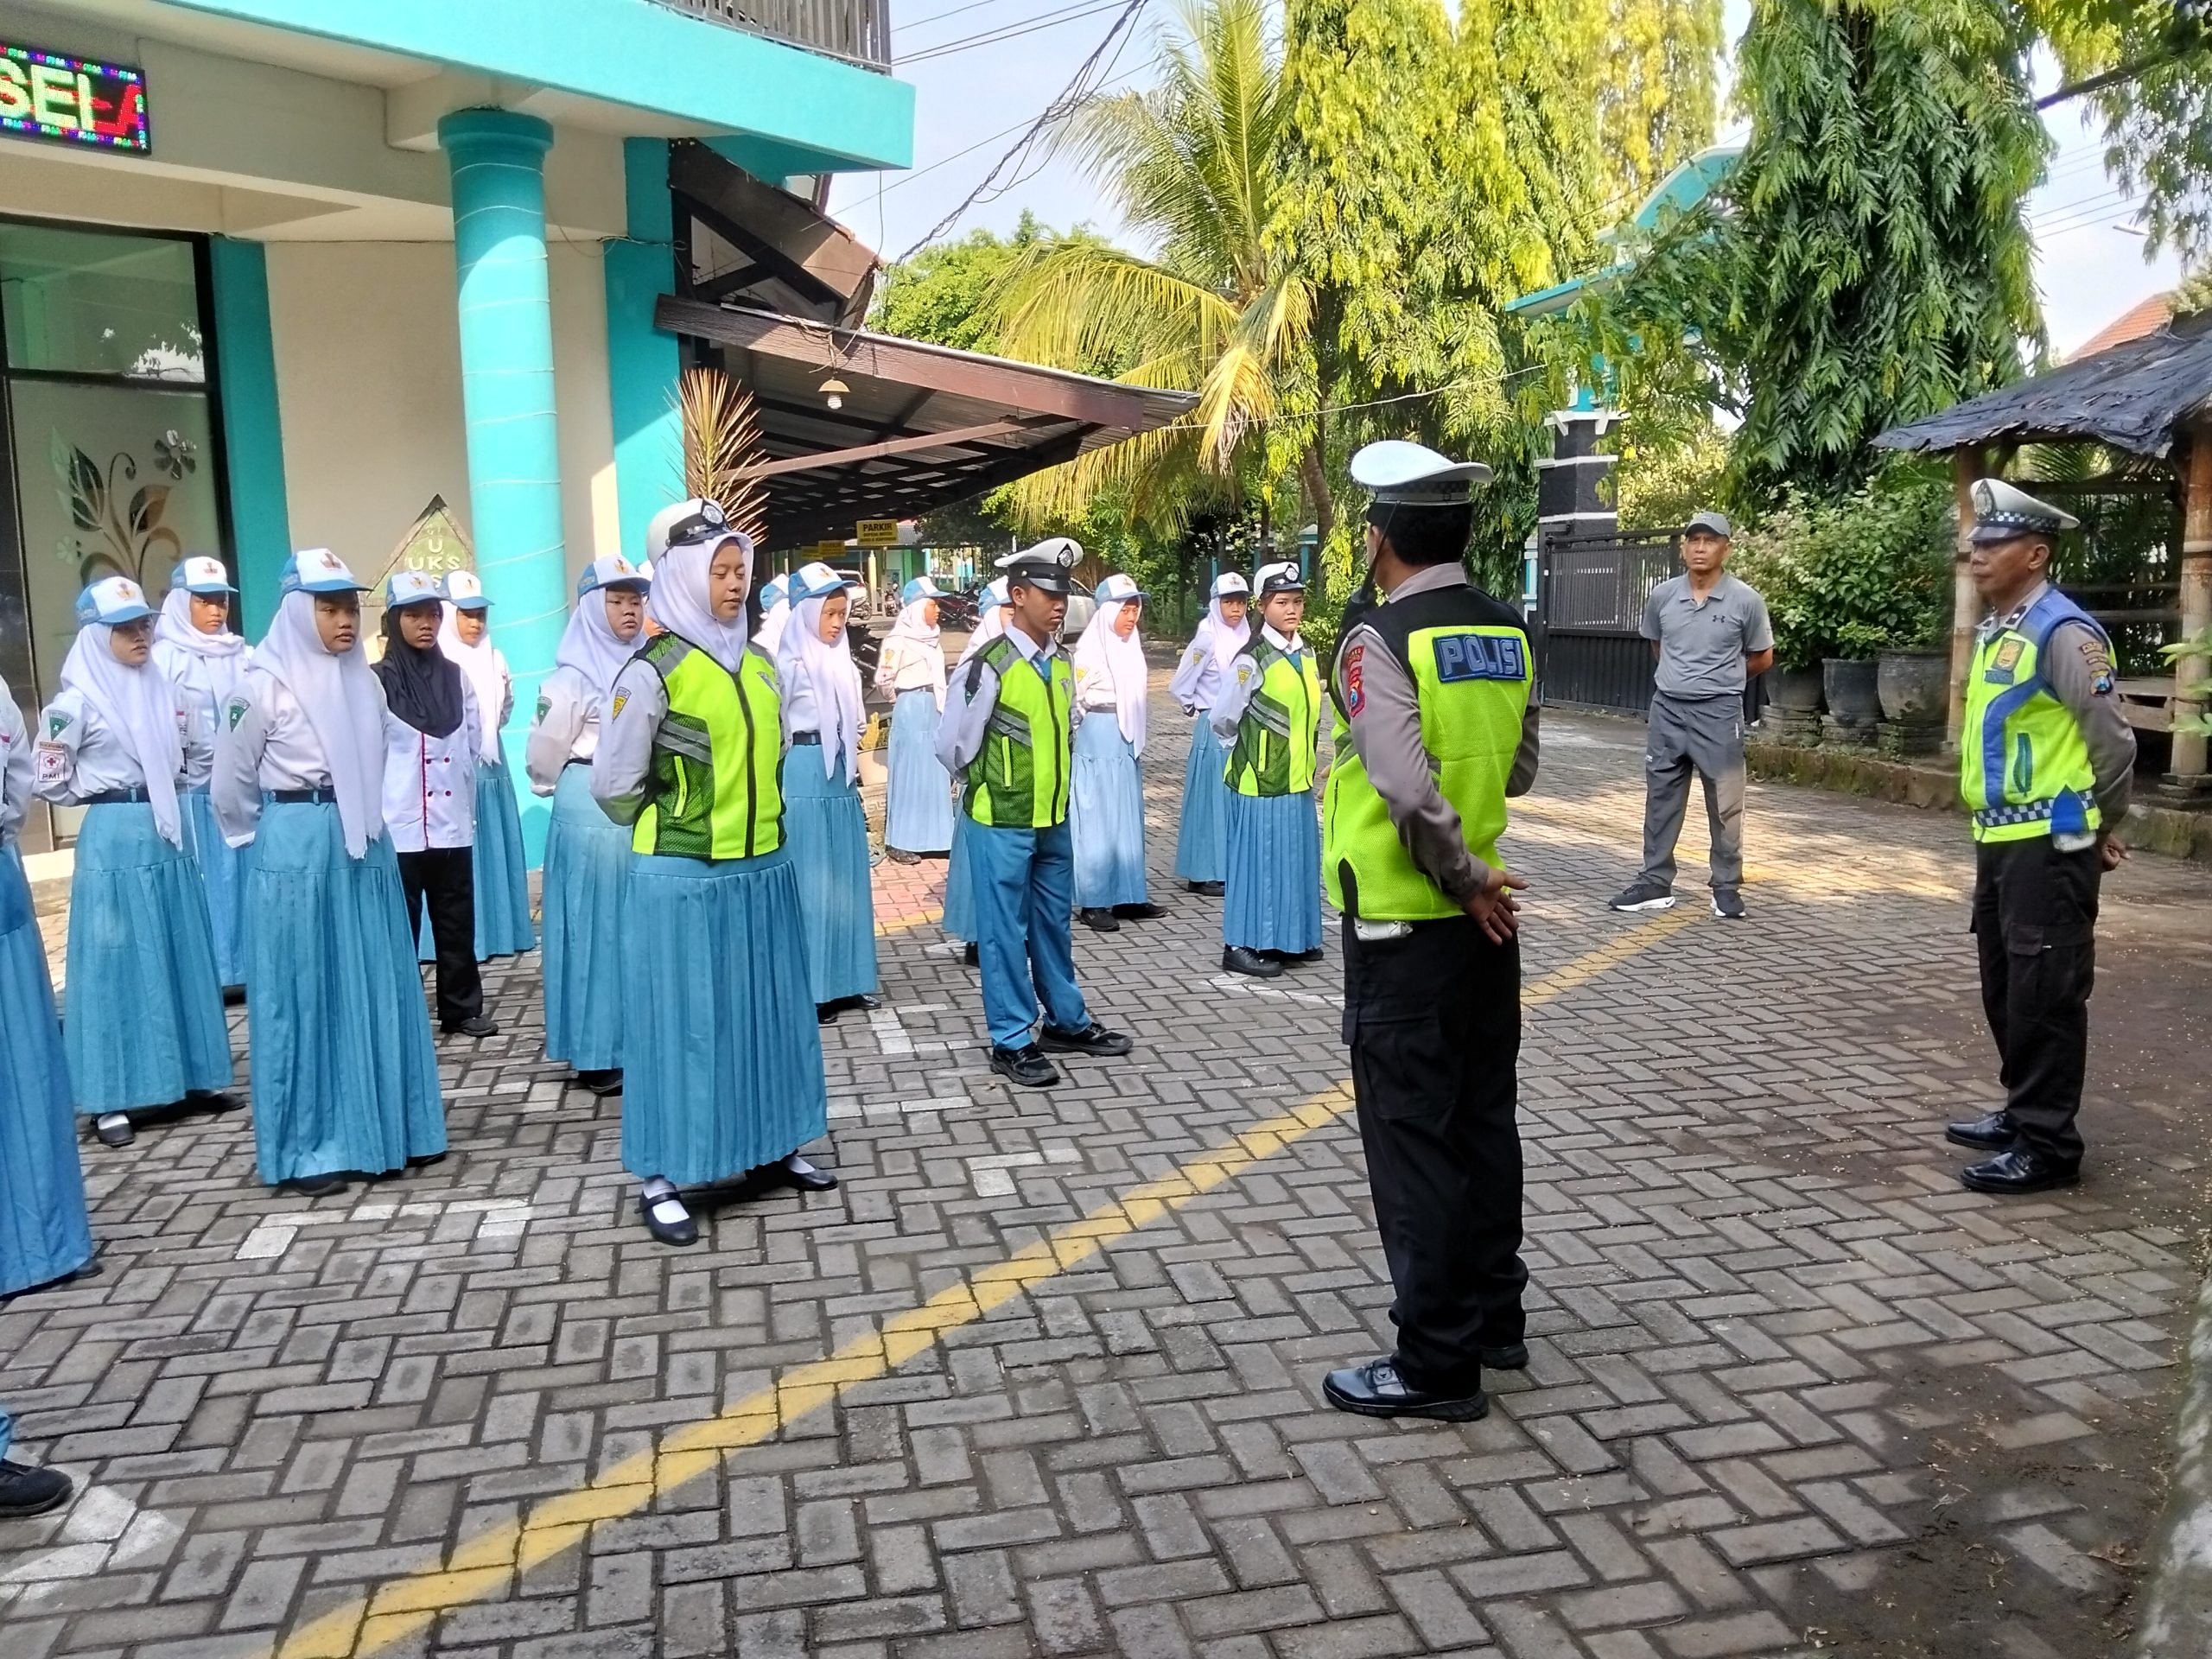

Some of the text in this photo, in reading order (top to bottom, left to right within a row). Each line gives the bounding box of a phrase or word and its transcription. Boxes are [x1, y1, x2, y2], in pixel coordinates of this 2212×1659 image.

[863, 523, 892, 531] PARKIR
[429, 538, 442, 553] U
[408, 556, 461, 571] UKS
[1438, 635, 1523, 676] POLISI
